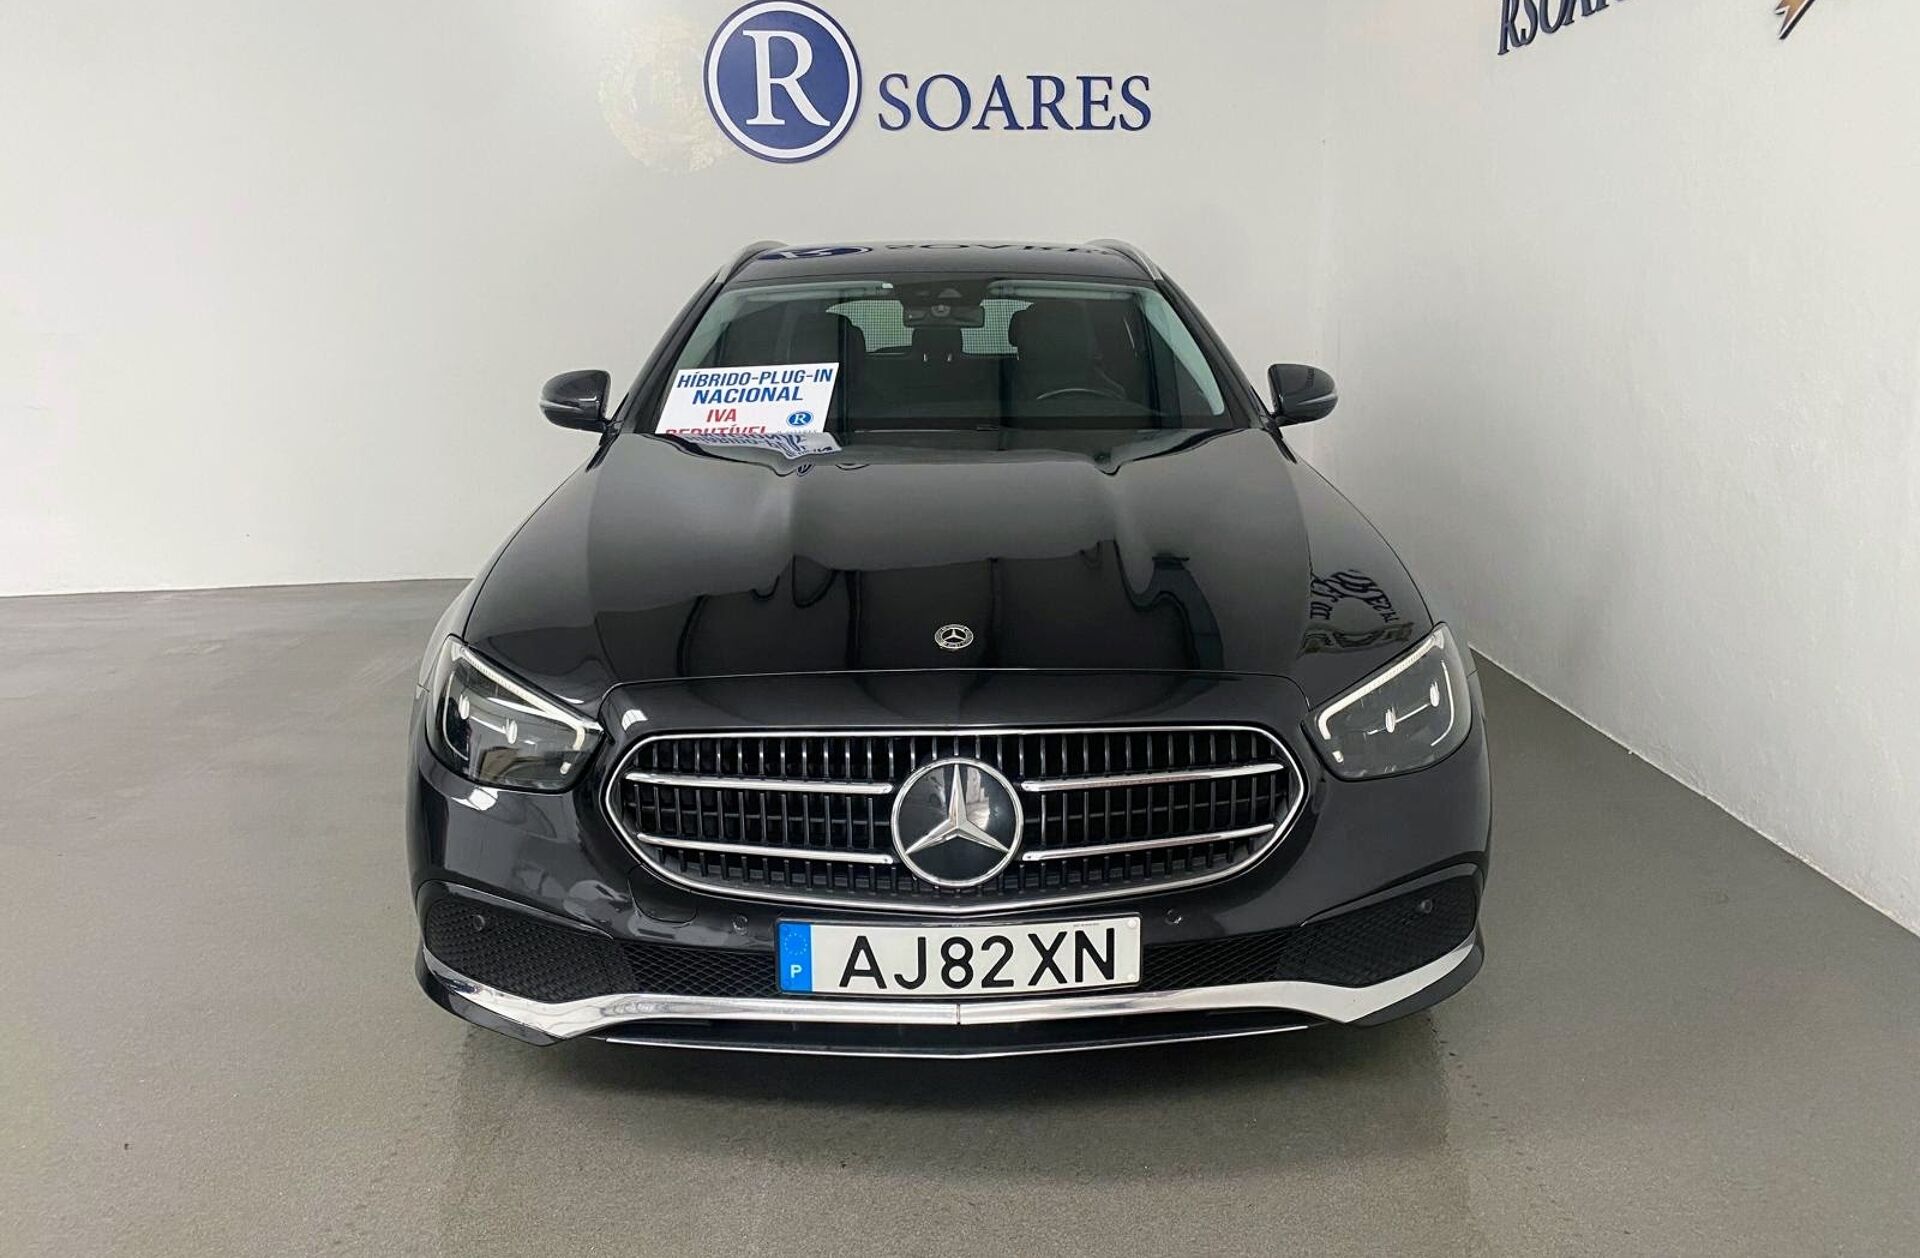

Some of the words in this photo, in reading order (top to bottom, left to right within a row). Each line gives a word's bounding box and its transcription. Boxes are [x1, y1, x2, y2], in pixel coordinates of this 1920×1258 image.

[743, 28, 831, 126] R
[877, 73, 1152, 132] SOARES
[677, 368, 833, 389] HÍBRIDO-PLUG-IN
[692, 386, 804, 405] NACIONAL
[706, 408, 736, 422] IVA
[790, 964, 802, 978] P
